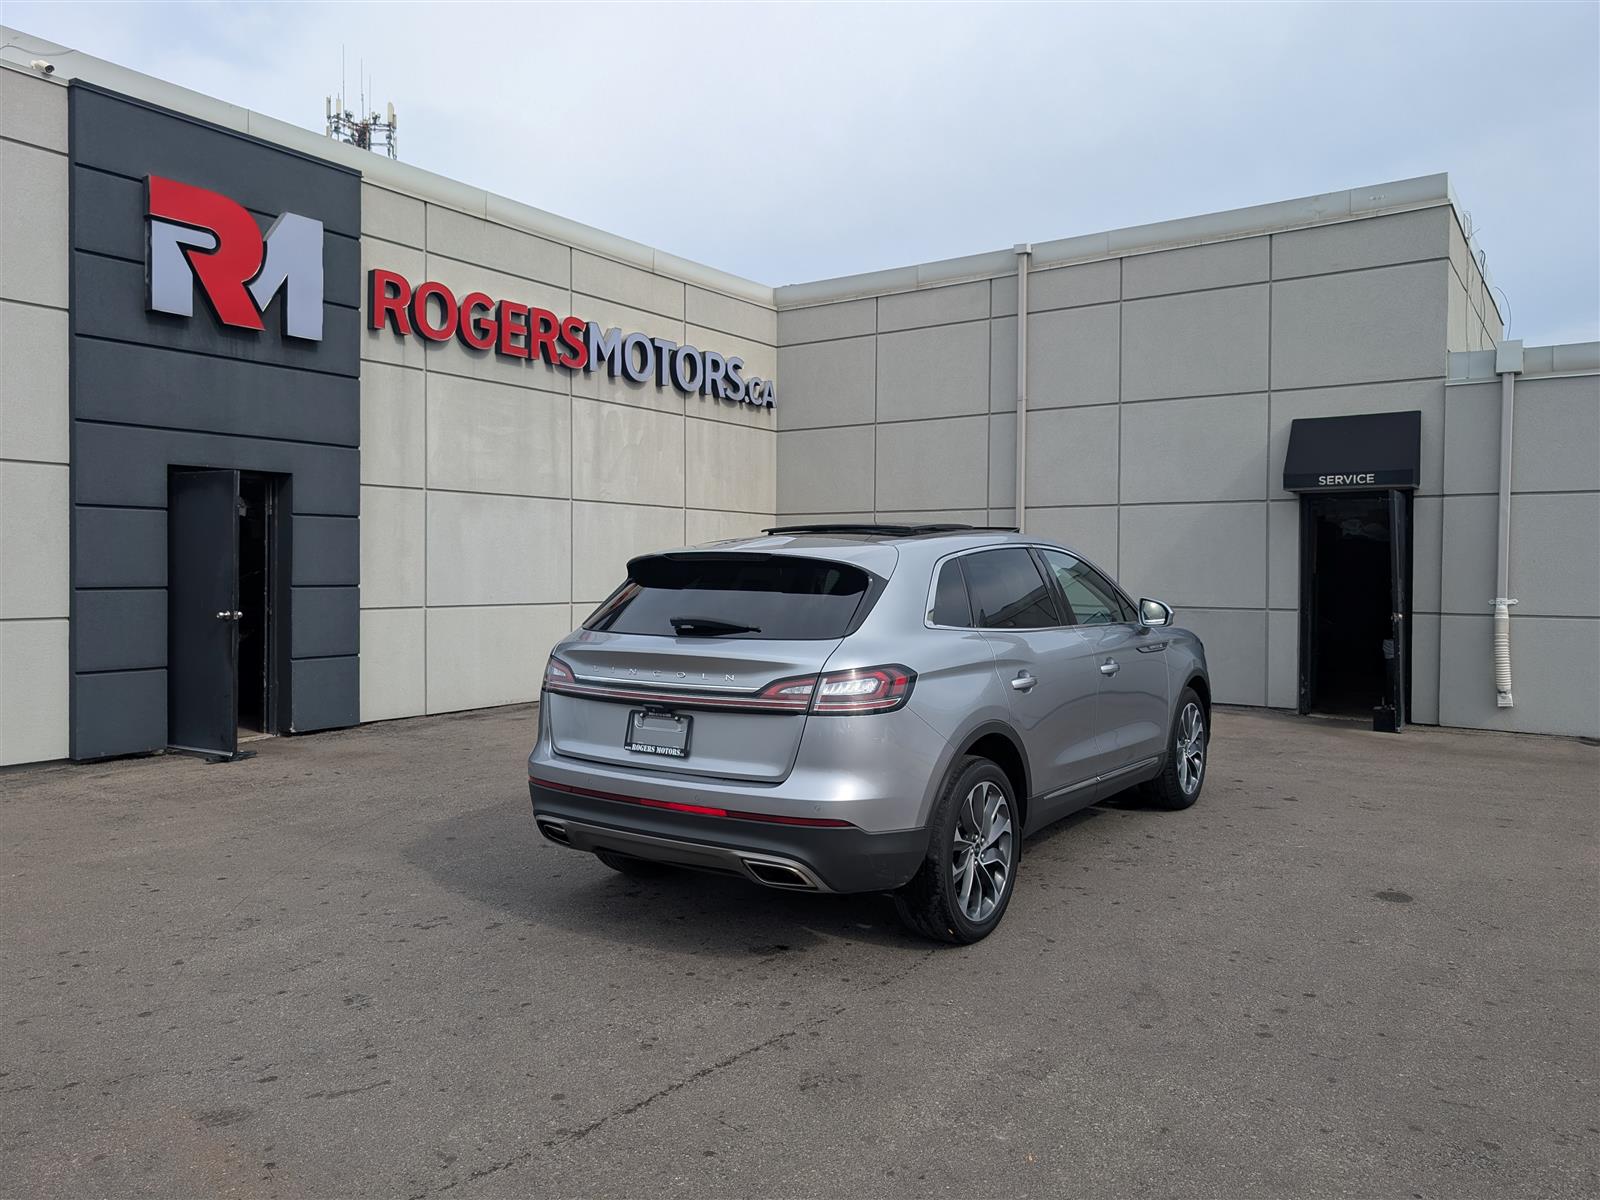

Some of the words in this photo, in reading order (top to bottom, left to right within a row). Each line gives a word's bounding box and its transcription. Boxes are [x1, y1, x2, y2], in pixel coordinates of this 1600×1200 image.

[1318, 473, 1376, 486] SERVICE
[591, 664, 736, 682] LINCOLN
[631, 743, 656, 753] ROGERS
[656, 746, 681, 756] MOTORS
